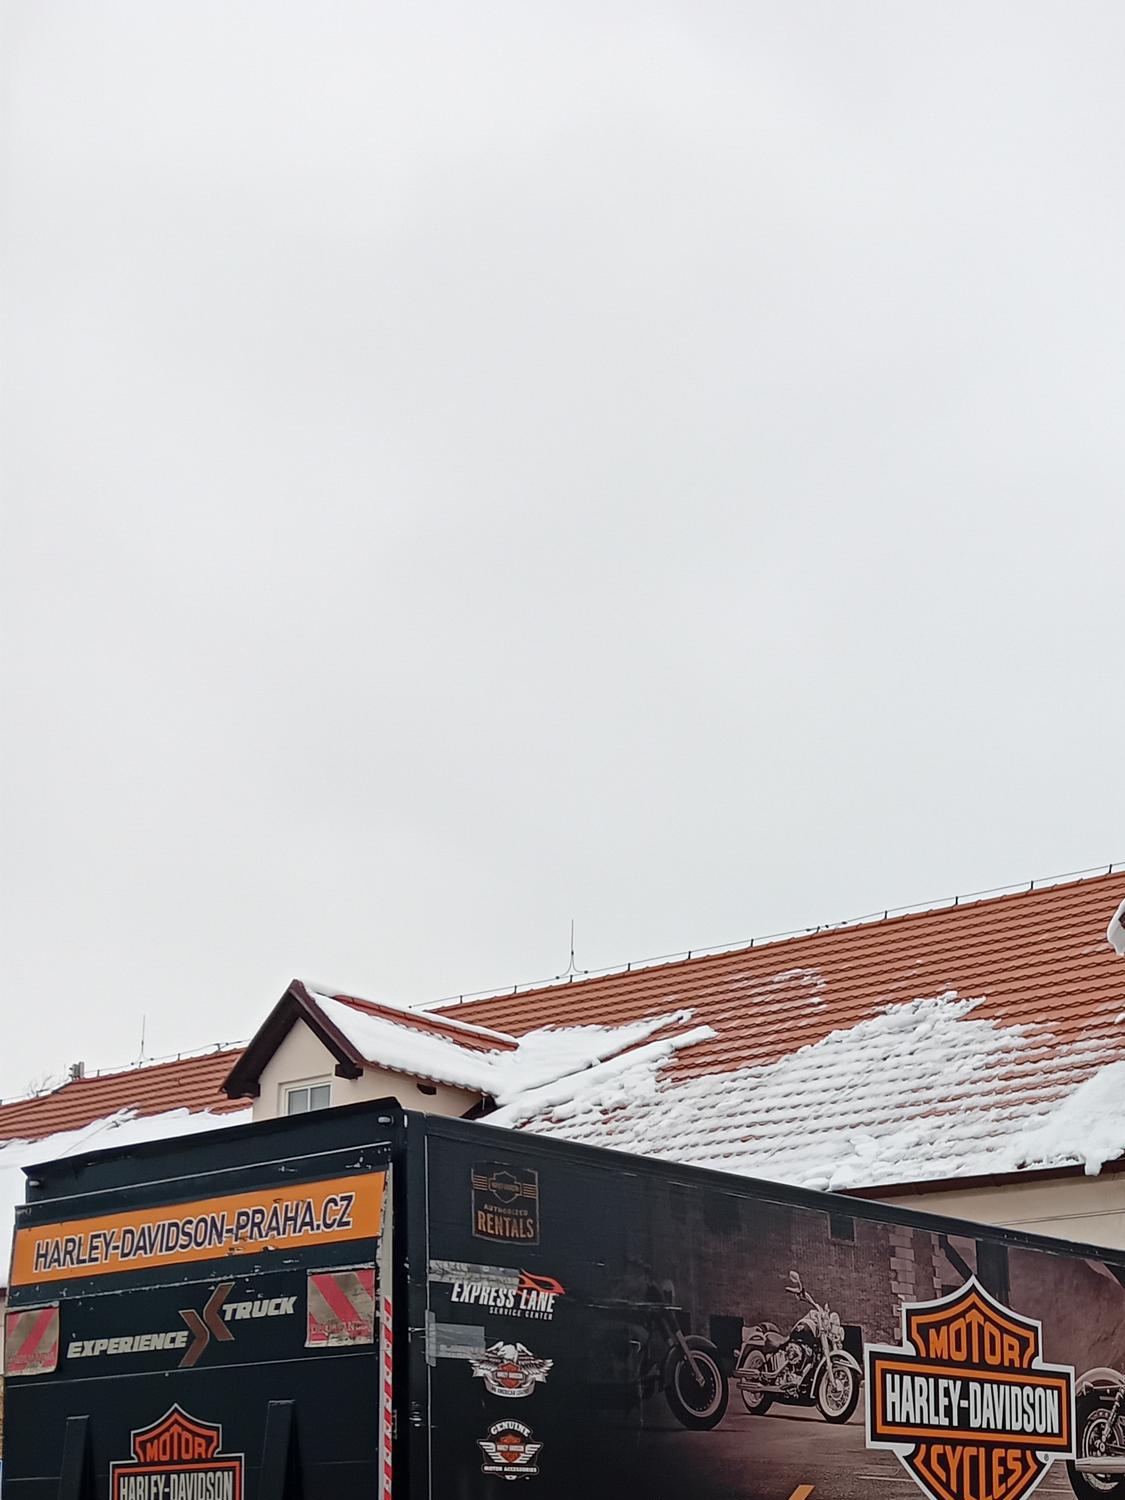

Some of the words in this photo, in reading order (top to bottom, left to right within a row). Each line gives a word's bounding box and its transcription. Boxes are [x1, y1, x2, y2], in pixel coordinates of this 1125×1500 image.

[33, 1193, 355, 1273] HARLEY-DAVIDSON-PRAHA.CZ
[478, 1210, 534, 1238] RENTALS
[450, 1281, 516, 1308] EXPRESS
[519, 1288, 559, 1313] LANE
[490, 1306, 521, 1317] SERVICE
[525, 1311, 553, 1321] CENTER
[67, 1330, 189, 1359] EXPERIENCE
[222, 1296, 297, 1321] TRUCK
[929, 1308, 1020, 1368] MOTOR
[886, 1374, 1059, 1434] HARLEY-DAVIDSON
[145, 1424, 207, 1462] MOTOR
[490, 1421, 531, 1437] GENUINE
